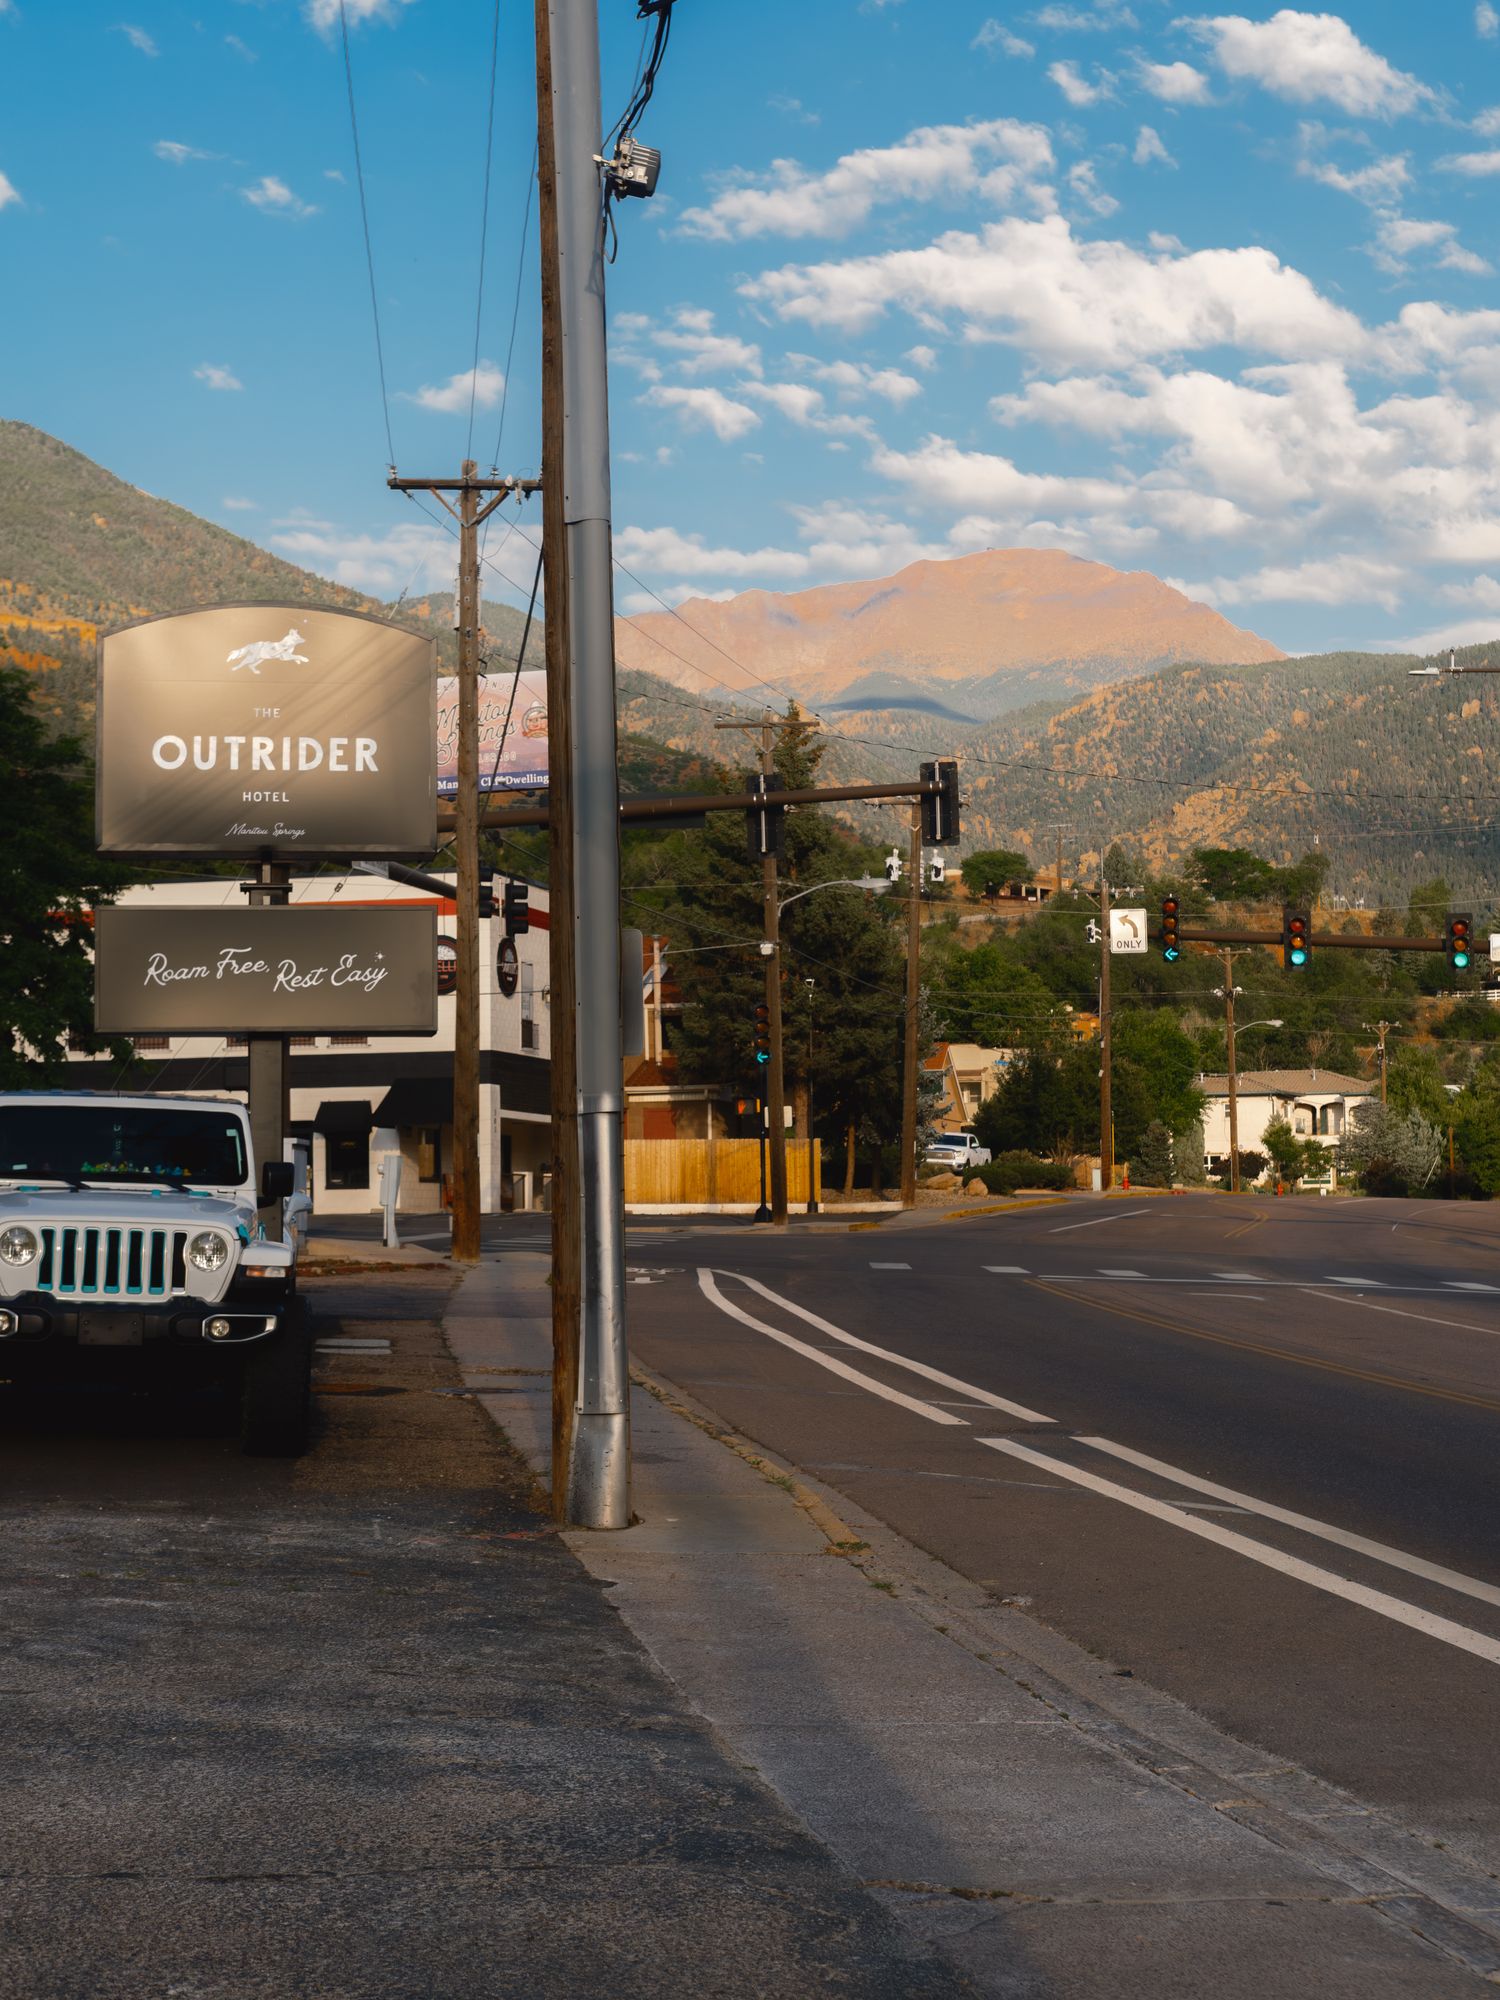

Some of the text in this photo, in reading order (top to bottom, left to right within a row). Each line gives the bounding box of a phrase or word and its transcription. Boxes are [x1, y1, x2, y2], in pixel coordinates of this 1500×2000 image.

[254, 708, 281, 718] THE
[152, 735, 378, 772] OUTRIDER
[243, 792, 289, 803] HOTEL
[225, 823, 305, 840] Manitou Springs
[1116, 940, 1142, 949] ONLY
[144, 953, 209, 986] Roam
[273, 959, 327, 992] Rest
[331, 954, 388, 992] Easy
